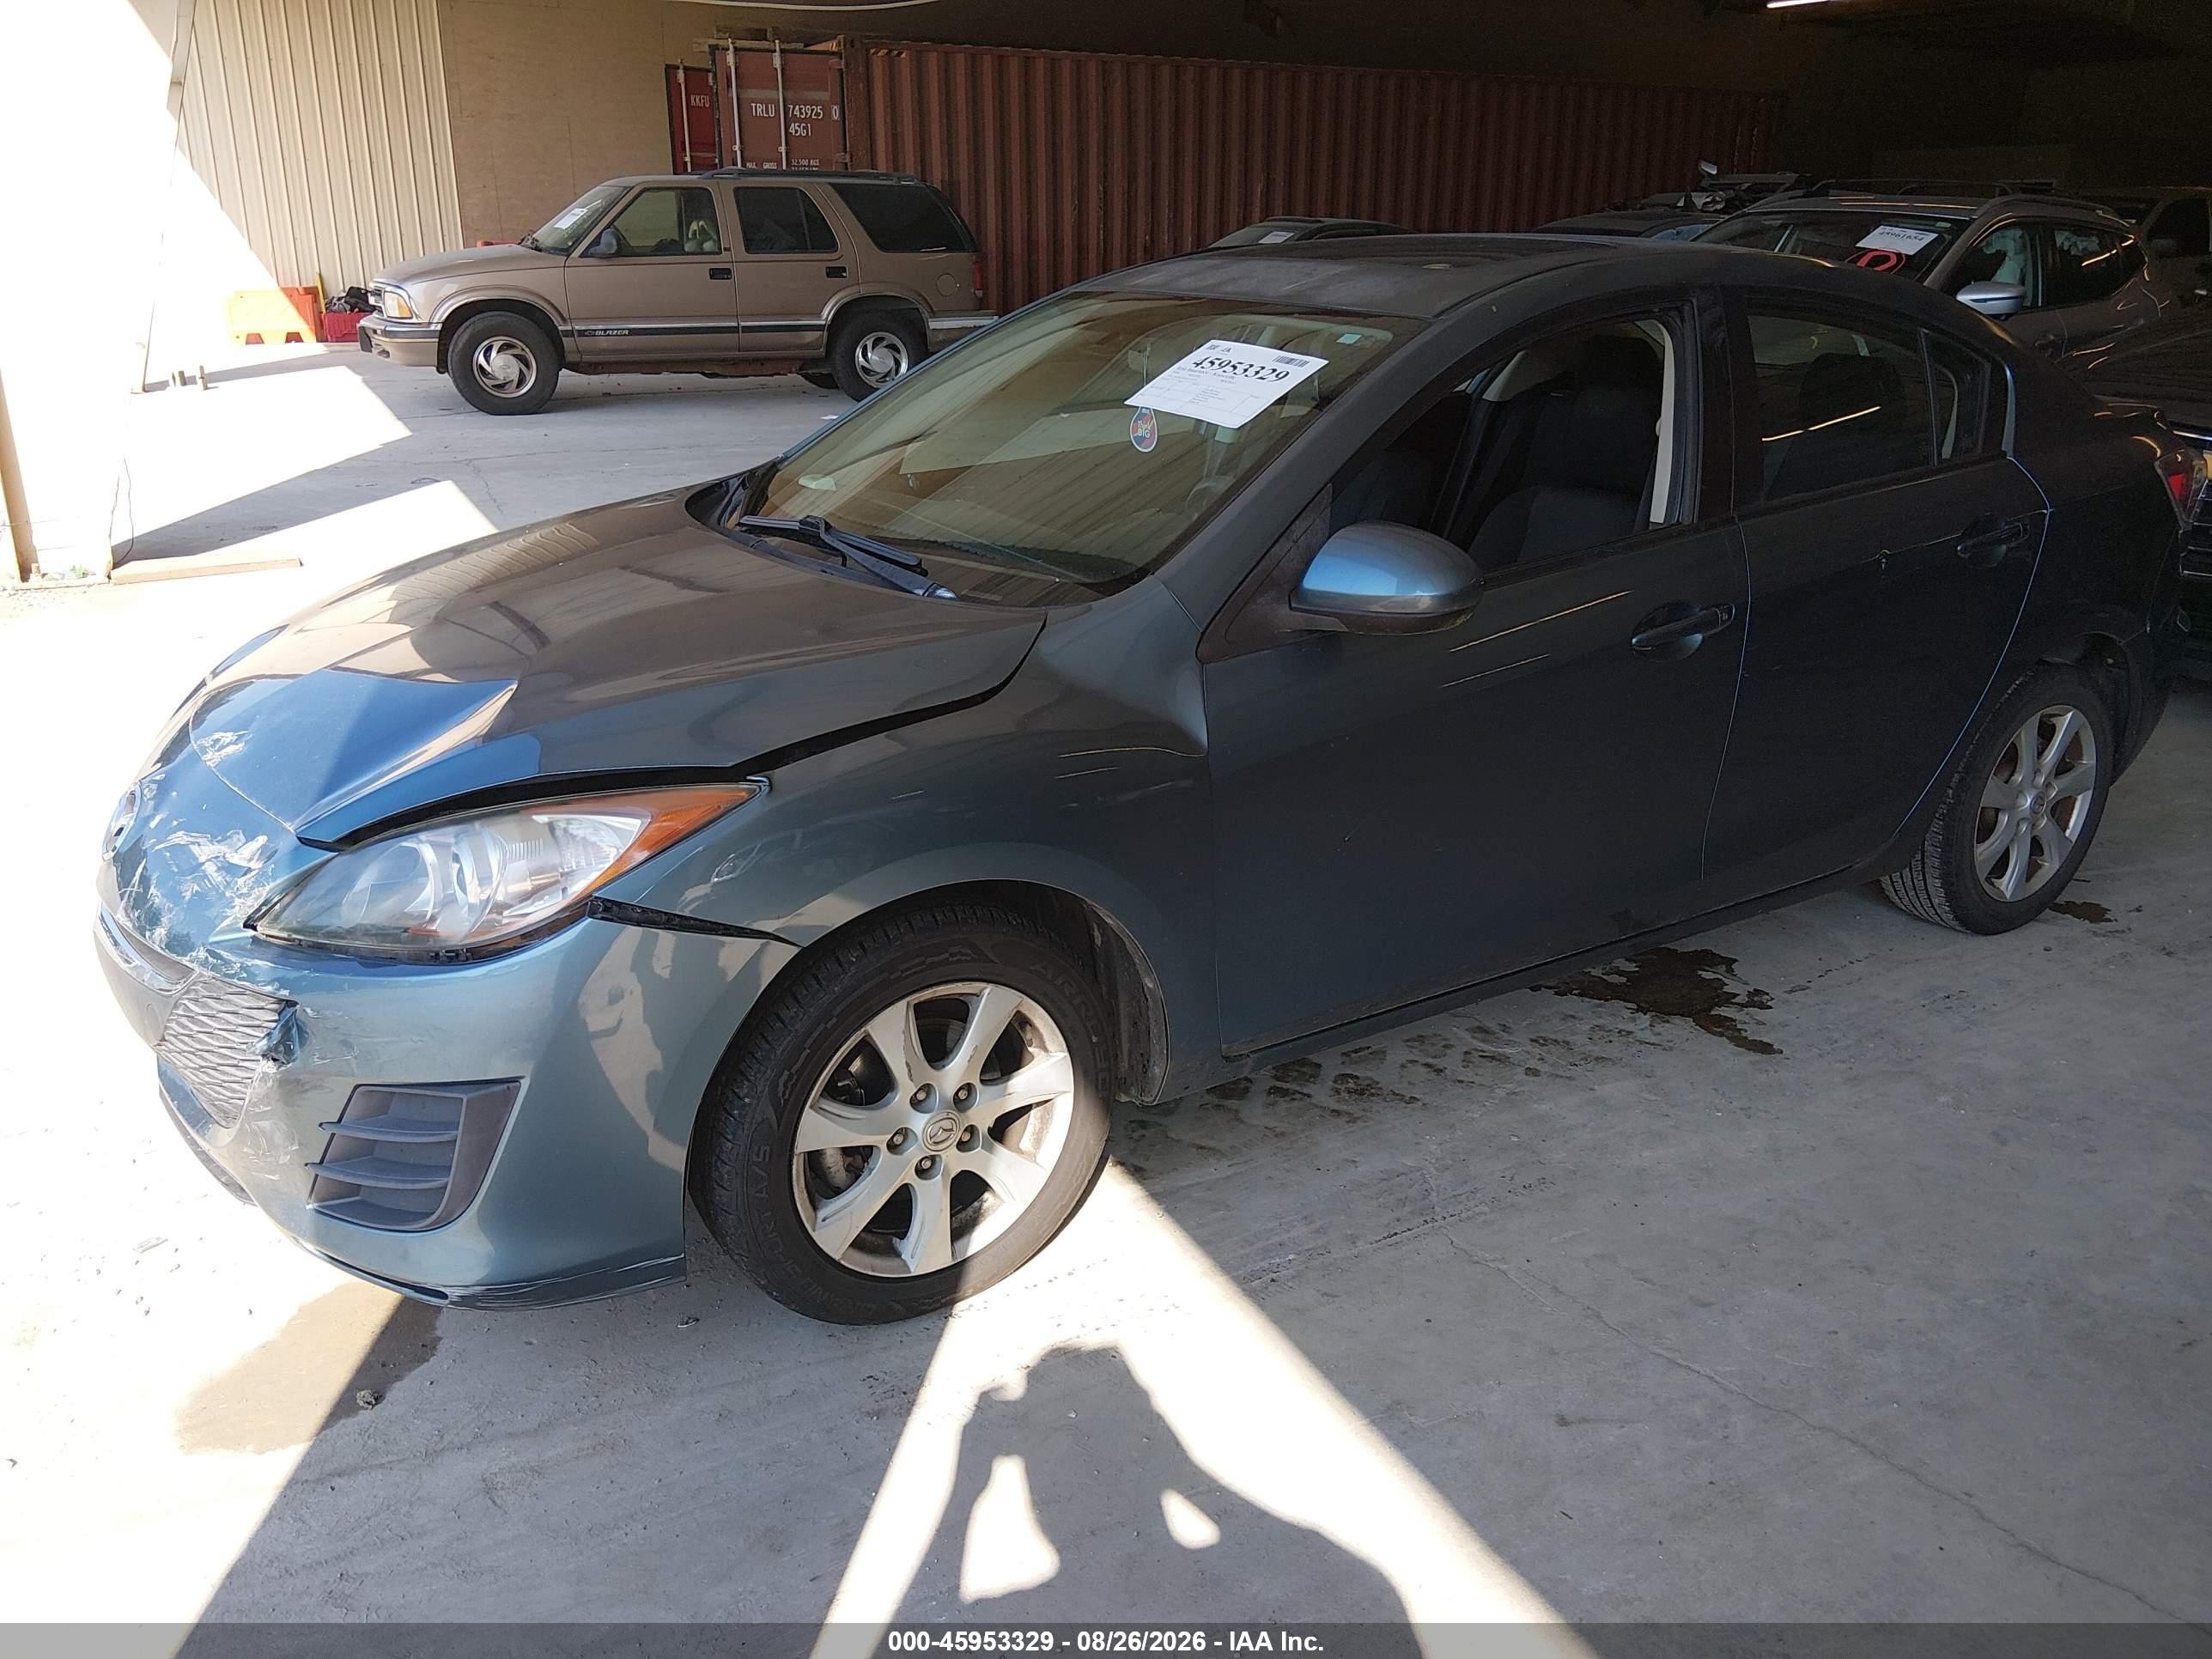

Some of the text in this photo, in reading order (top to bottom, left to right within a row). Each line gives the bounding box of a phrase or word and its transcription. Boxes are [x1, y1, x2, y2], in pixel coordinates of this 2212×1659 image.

[690, 94, 709, 107] KKFU
[751, 103, 839, 119] TRLU 743925 0
[788, 123, 811, 137] 45G1
[1192, 356, 1290, 382] 45953329
[751, 1144, 770, 1202] A/S
